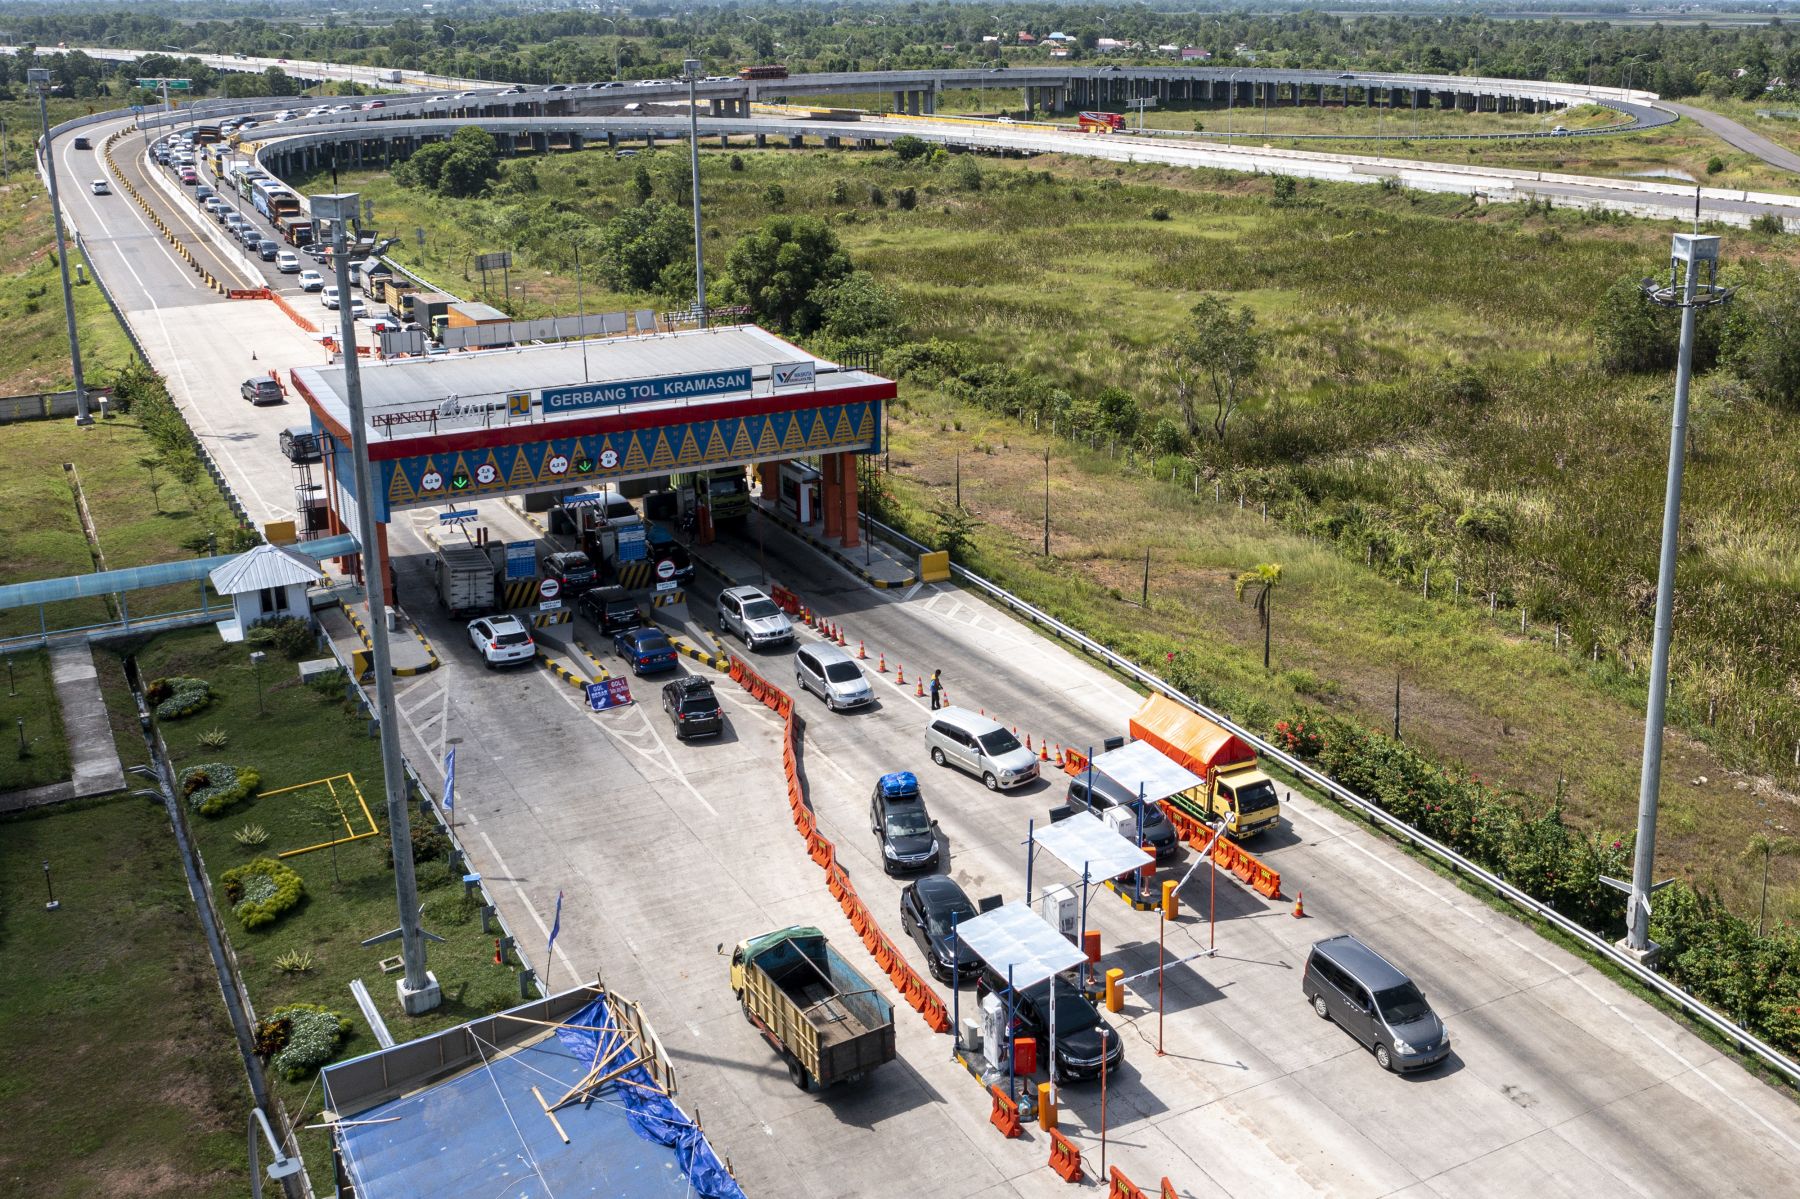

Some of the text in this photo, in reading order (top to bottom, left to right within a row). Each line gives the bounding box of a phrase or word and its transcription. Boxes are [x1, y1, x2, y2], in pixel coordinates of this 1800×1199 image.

[550, 375, 746, 406] GERBANG TOL KRAMASAN
